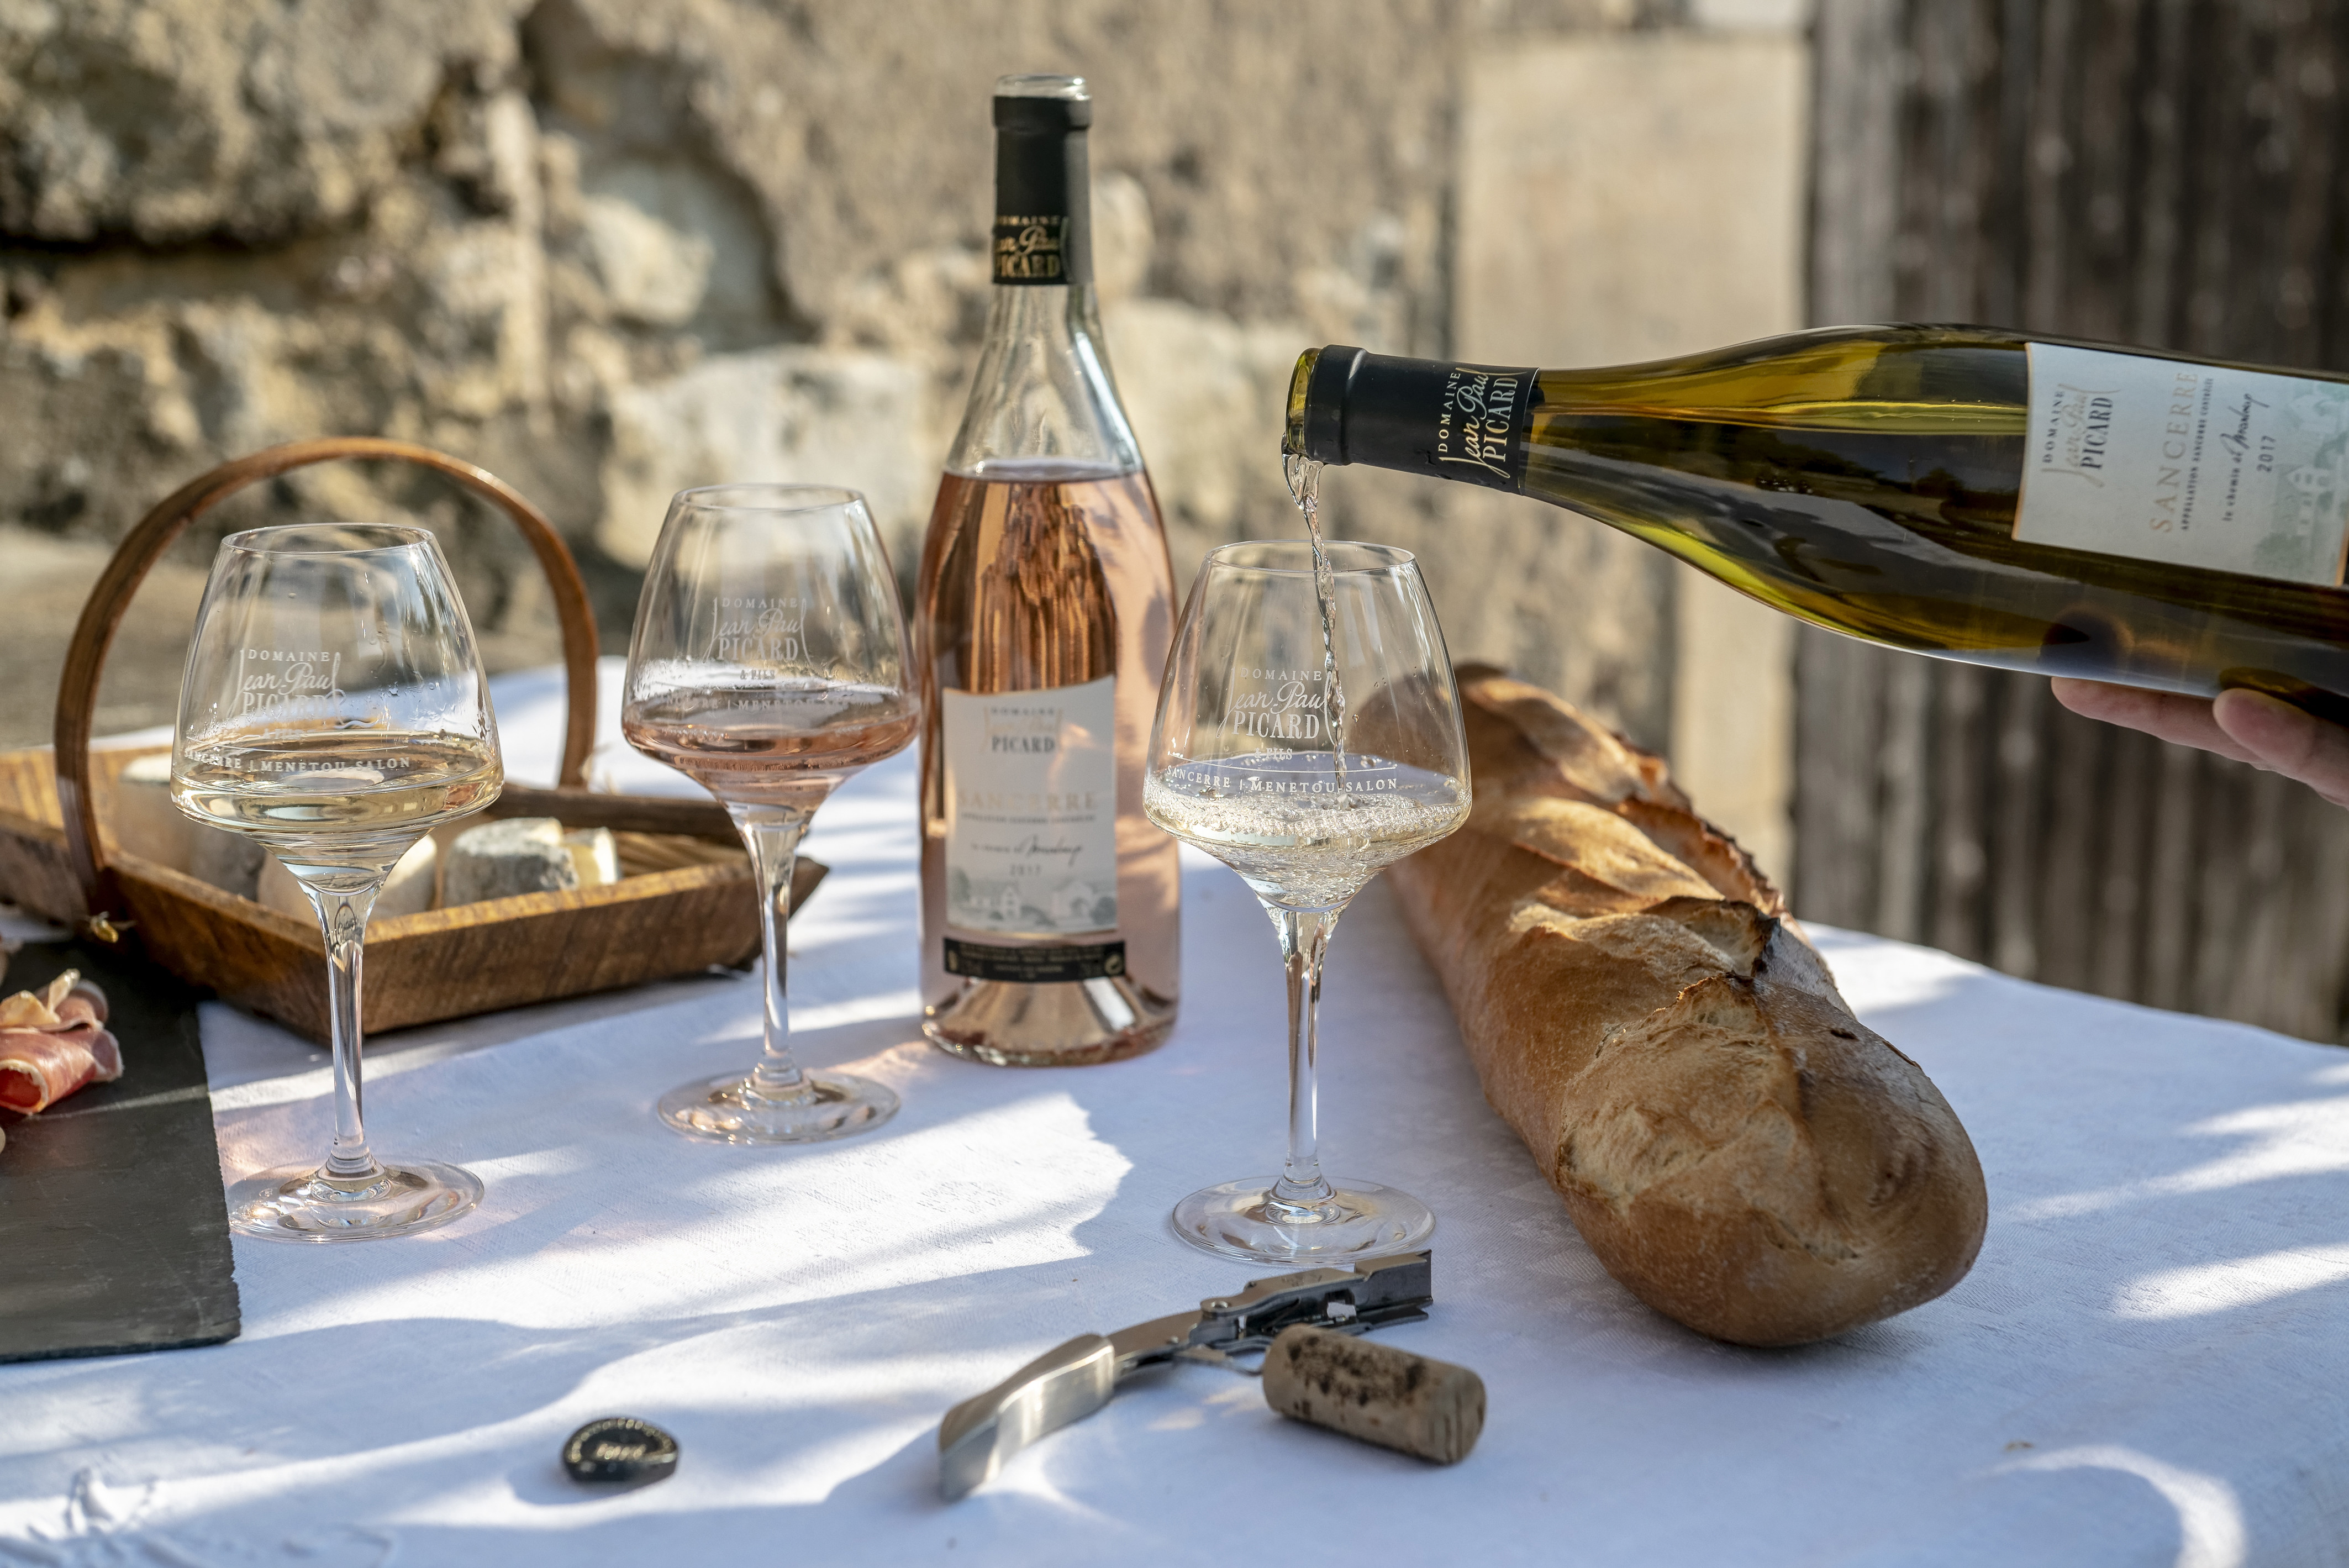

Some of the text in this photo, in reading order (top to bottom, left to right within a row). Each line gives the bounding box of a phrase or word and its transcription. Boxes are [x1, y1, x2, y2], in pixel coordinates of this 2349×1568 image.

[1439, 373, 1461, 453] DOMAINE
[1483, 377, 1518, 462] PICARD
[2042, 391, 2064, 463] DOMAINE
[2080, 397, 2113, 469] PICARD
[2149, 373, 2198, 533] SANCERRE
[2256, 435, 2276, 472] 2017
[722, 598, 798, 608] DOMAINE
[247, 649, 330, 662] DOMAINE
[718, 637, 799, 661] PICARD
[1240, 667, 1322, 681] DOMAINE
[1231, 711, 1320, 739] PICARD
[992, 736, 1055, 753] PICARD
[1254, 748, 1293, 760] & FILS
[1167, 765, 1230, 788] SANCERRE
